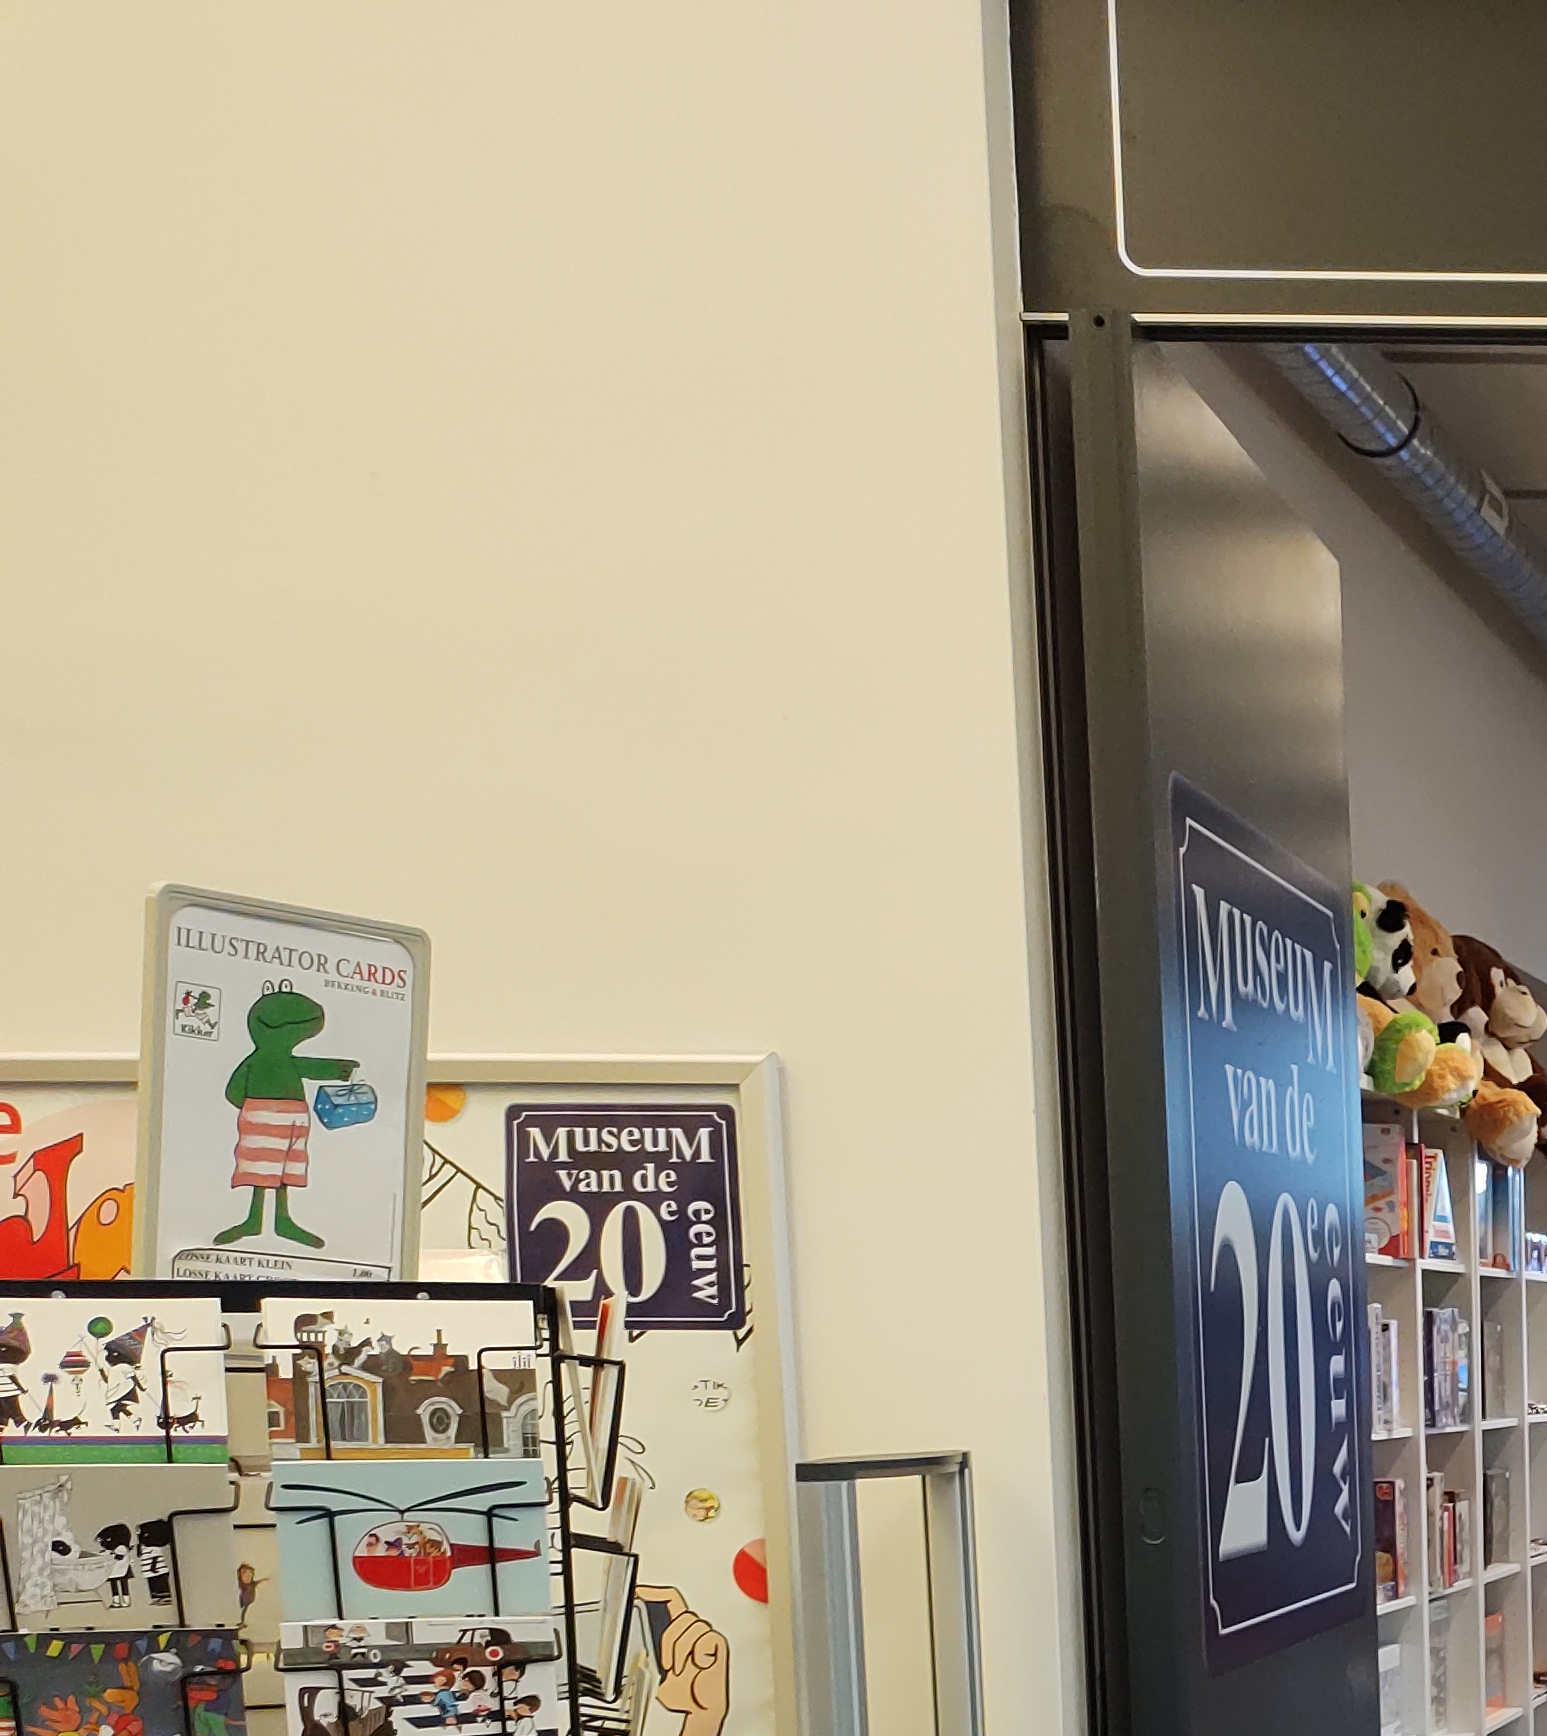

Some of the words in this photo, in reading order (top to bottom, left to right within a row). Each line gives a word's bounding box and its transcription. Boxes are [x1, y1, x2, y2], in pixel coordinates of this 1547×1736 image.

[175, 925, 330, 975] ILLUSTRATOR
[336, 958, 408, 989] CARDS
[324, 978, 370, 995] BEKKING
[379, 989, 406, 1001] BLITZ
[1223, 1062, 1278, 1154] van
[1283, 1062, 1317, 1166] de
[555, 1168, 624, 1193] van
[632, 1163, 679, 1193] de
[214, 1253, 254, 1268] KAART
[257, 1258, 294, 1271] KLEIN
[687, 1200, 720, 1306] eeuw
[1322, 1201, 1354, 1540] eeuw
